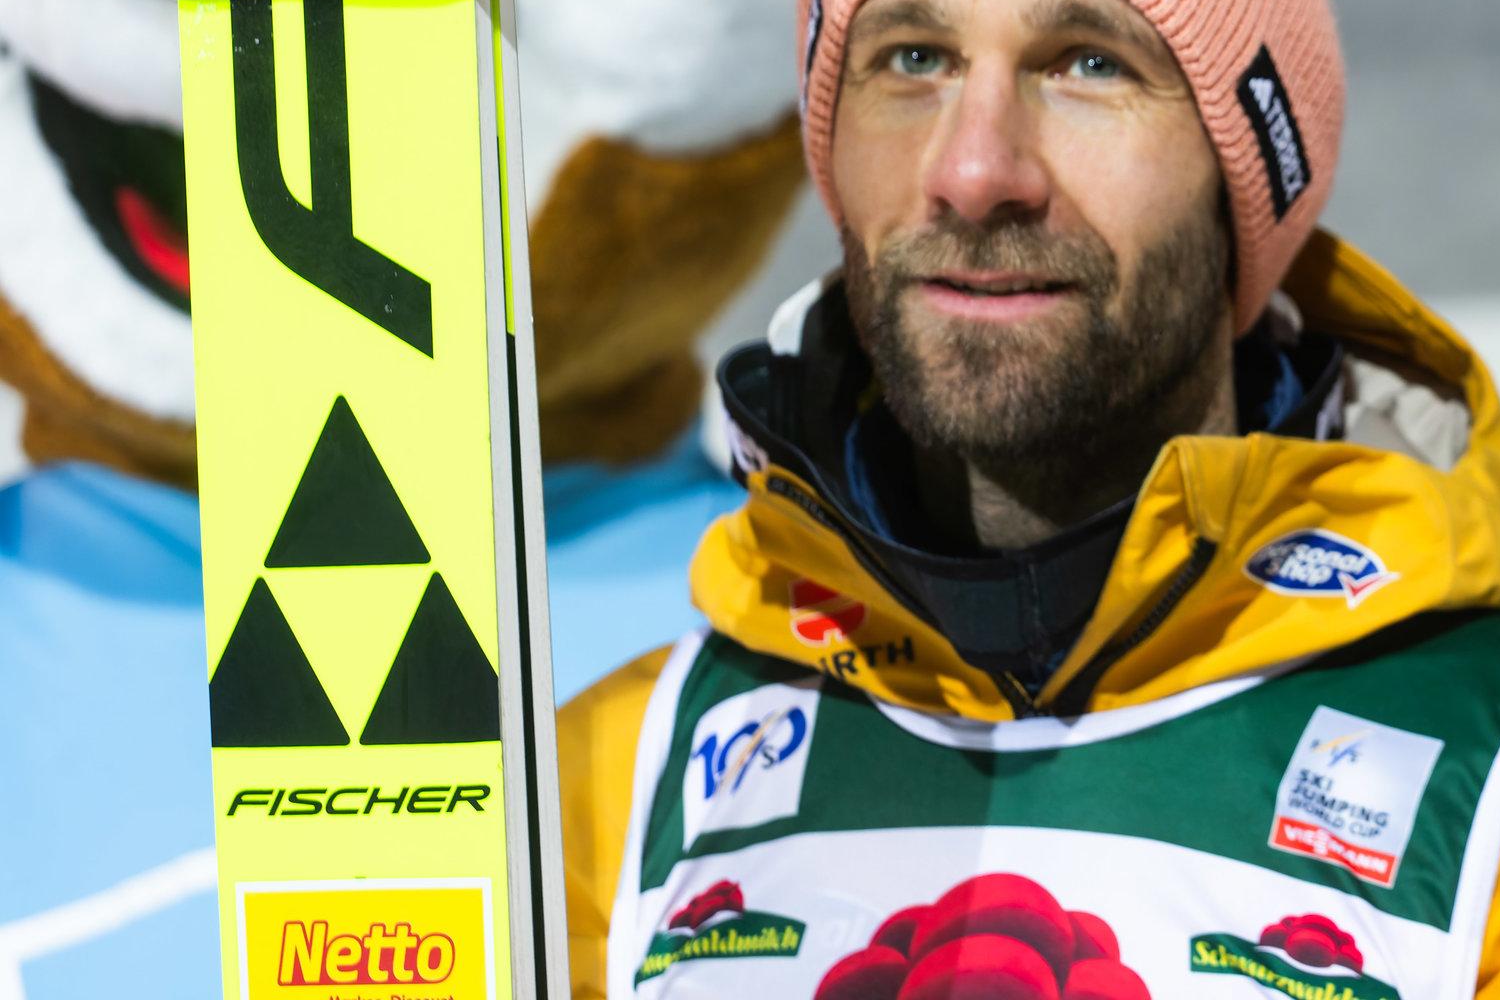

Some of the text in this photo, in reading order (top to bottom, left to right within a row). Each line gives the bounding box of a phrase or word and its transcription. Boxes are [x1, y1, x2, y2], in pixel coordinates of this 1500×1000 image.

[226, 784, 492, 816] FISCHER
[1299, 768, 1334, 791] SKI
[1288, 797, 1381, 838] WORLD CUP
[1293, 784, 1390, 828] JUMPING
[277, 920, 456, 986] Netto
